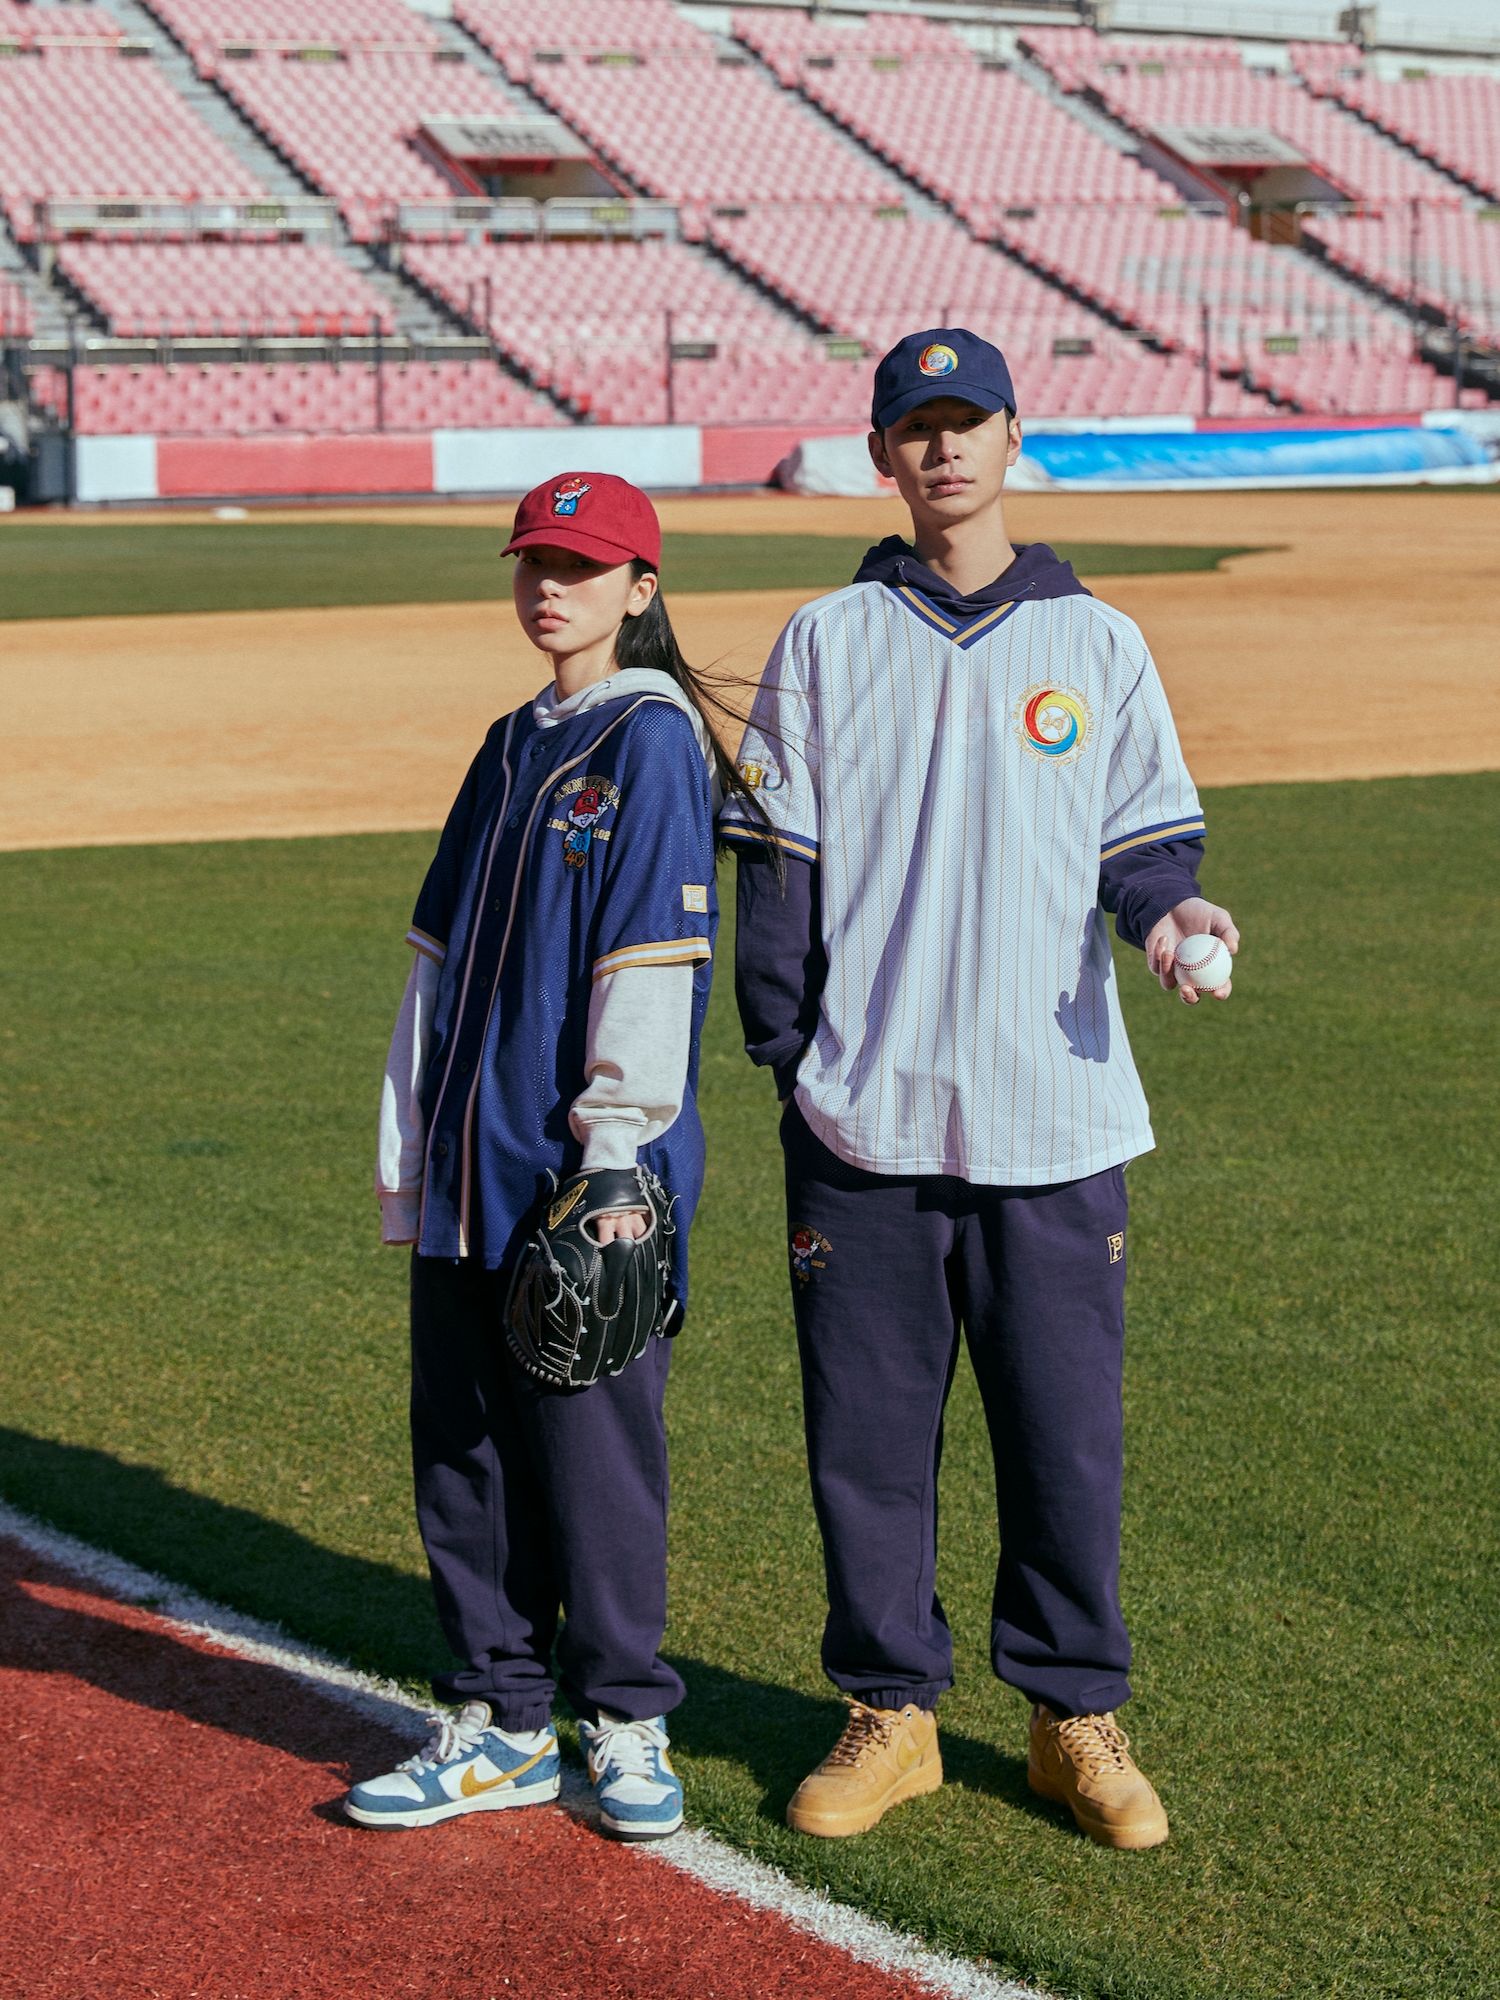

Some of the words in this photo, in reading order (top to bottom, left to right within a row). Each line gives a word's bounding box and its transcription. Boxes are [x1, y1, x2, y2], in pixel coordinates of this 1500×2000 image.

[1013, 680, 1064, 720] BASEBALL
[593, 828, 611, 841] 202
[563, 849, 587, 868] 40
